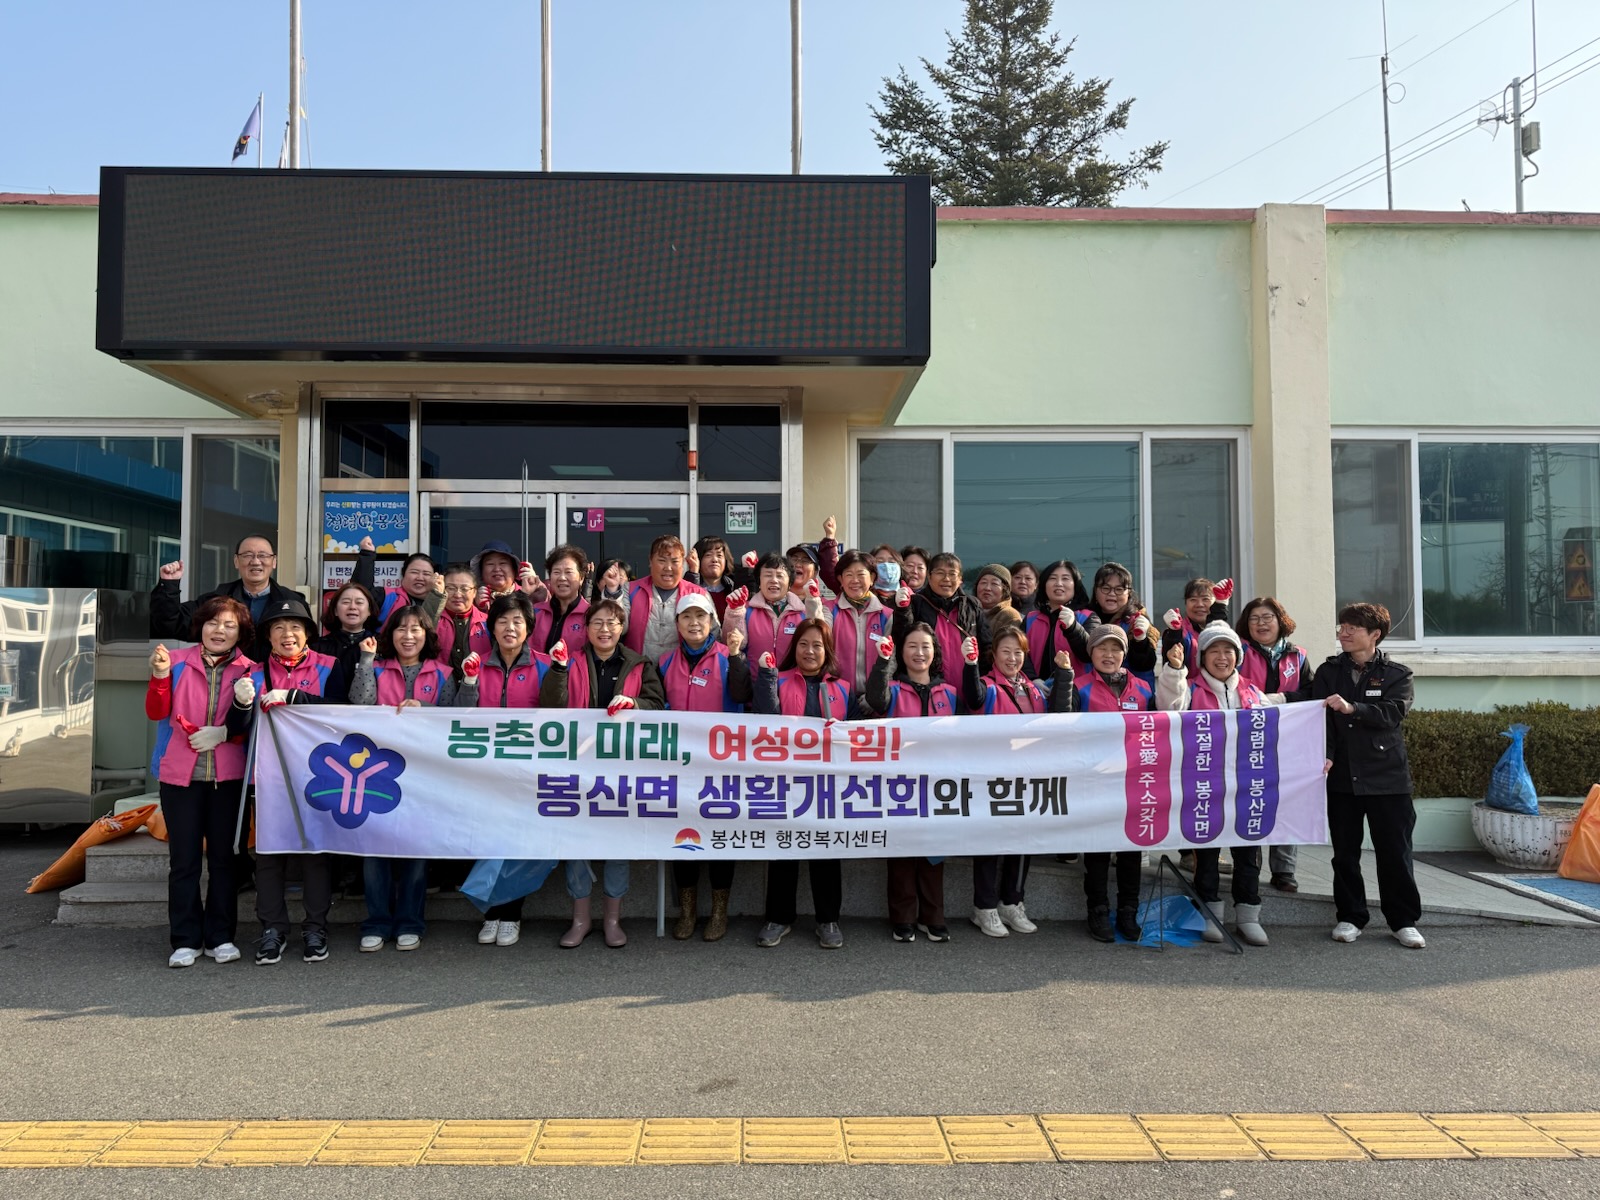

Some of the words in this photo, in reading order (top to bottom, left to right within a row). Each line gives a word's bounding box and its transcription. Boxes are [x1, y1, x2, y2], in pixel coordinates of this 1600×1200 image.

[375, 513, 408, 529] 봉산
[327, 578, 344, 588] 평일
[382, 578, 401, 587] 18:0
[335, 567, 352, 576] 면청
[373, 566, 398, 576] 영시간
[447, 720, 578, 760] 농촌의
[596, 721, 691, 766] 미래,
[708, 724, 832, 762] 여성의
[848, 726, 900, 762] 힘!
[1138, 715, 1158, 766] 김천愛
[1195, 713, 1212, 771] 친절한
[1249, 709, 1266, 769] 청렴한
[536, 774, 679, 819] 봉산면
[698, 774, 973, 820] 생활개선회와
[987, 776, 1068, 817] 함께
[1138, 771, 1158, 840] 주소갖기
[1193, 780, 1213, 839] 봉산면
[1247, 778, 1266, 836] 봉산면
[710, 829, 766, 850] 봉산면
[775, 829, 887, 849] 행정복지센터
